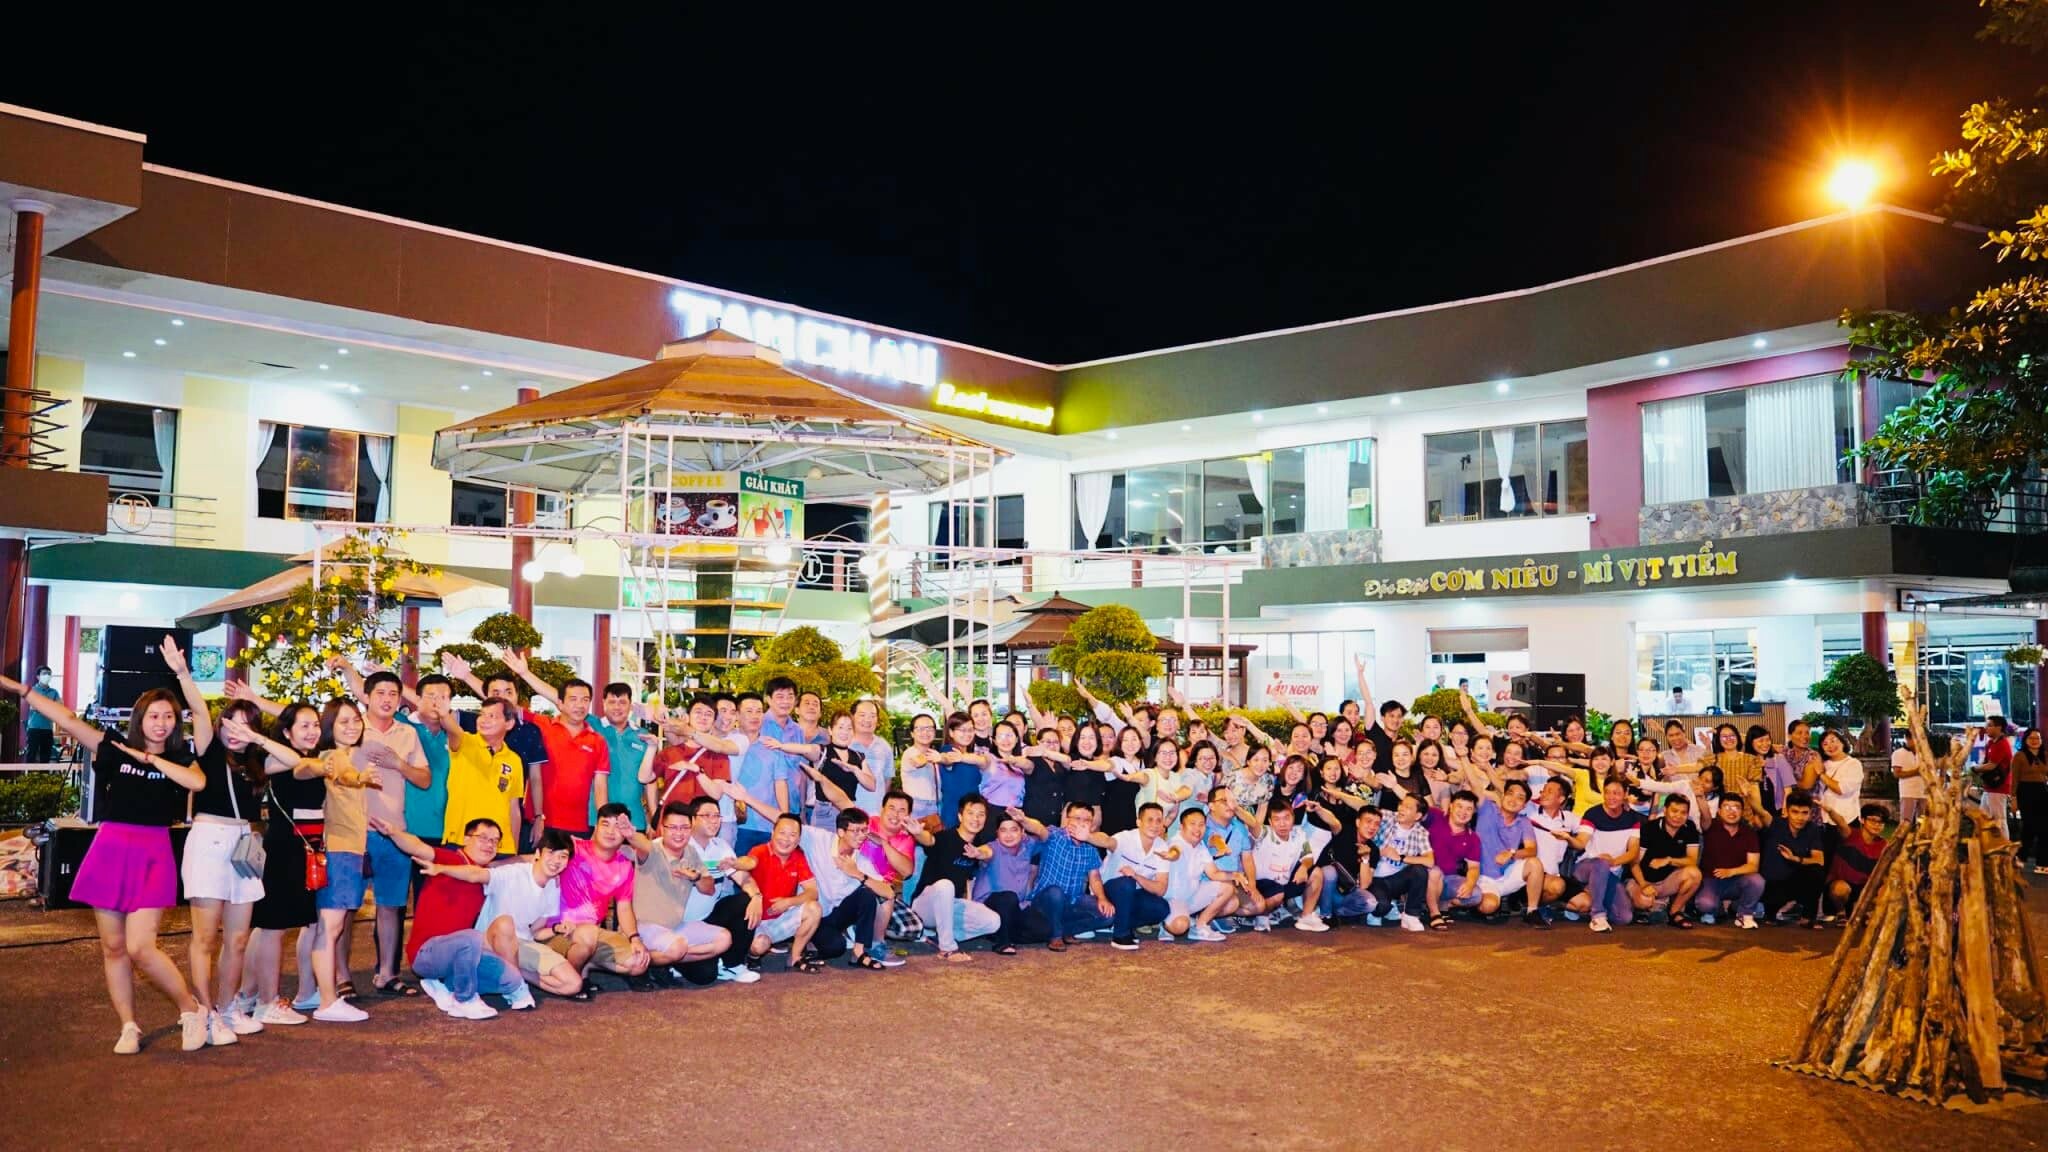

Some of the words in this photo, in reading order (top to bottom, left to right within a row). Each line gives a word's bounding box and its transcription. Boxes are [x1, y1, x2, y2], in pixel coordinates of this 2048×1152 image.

[770, 480, 798, 495] KHÁT
[1430, 567, 1485, 592] CƠM
[1491, 558, 1559, 590] NIÊU
[1617, 556, 1664, 587] VỊT
